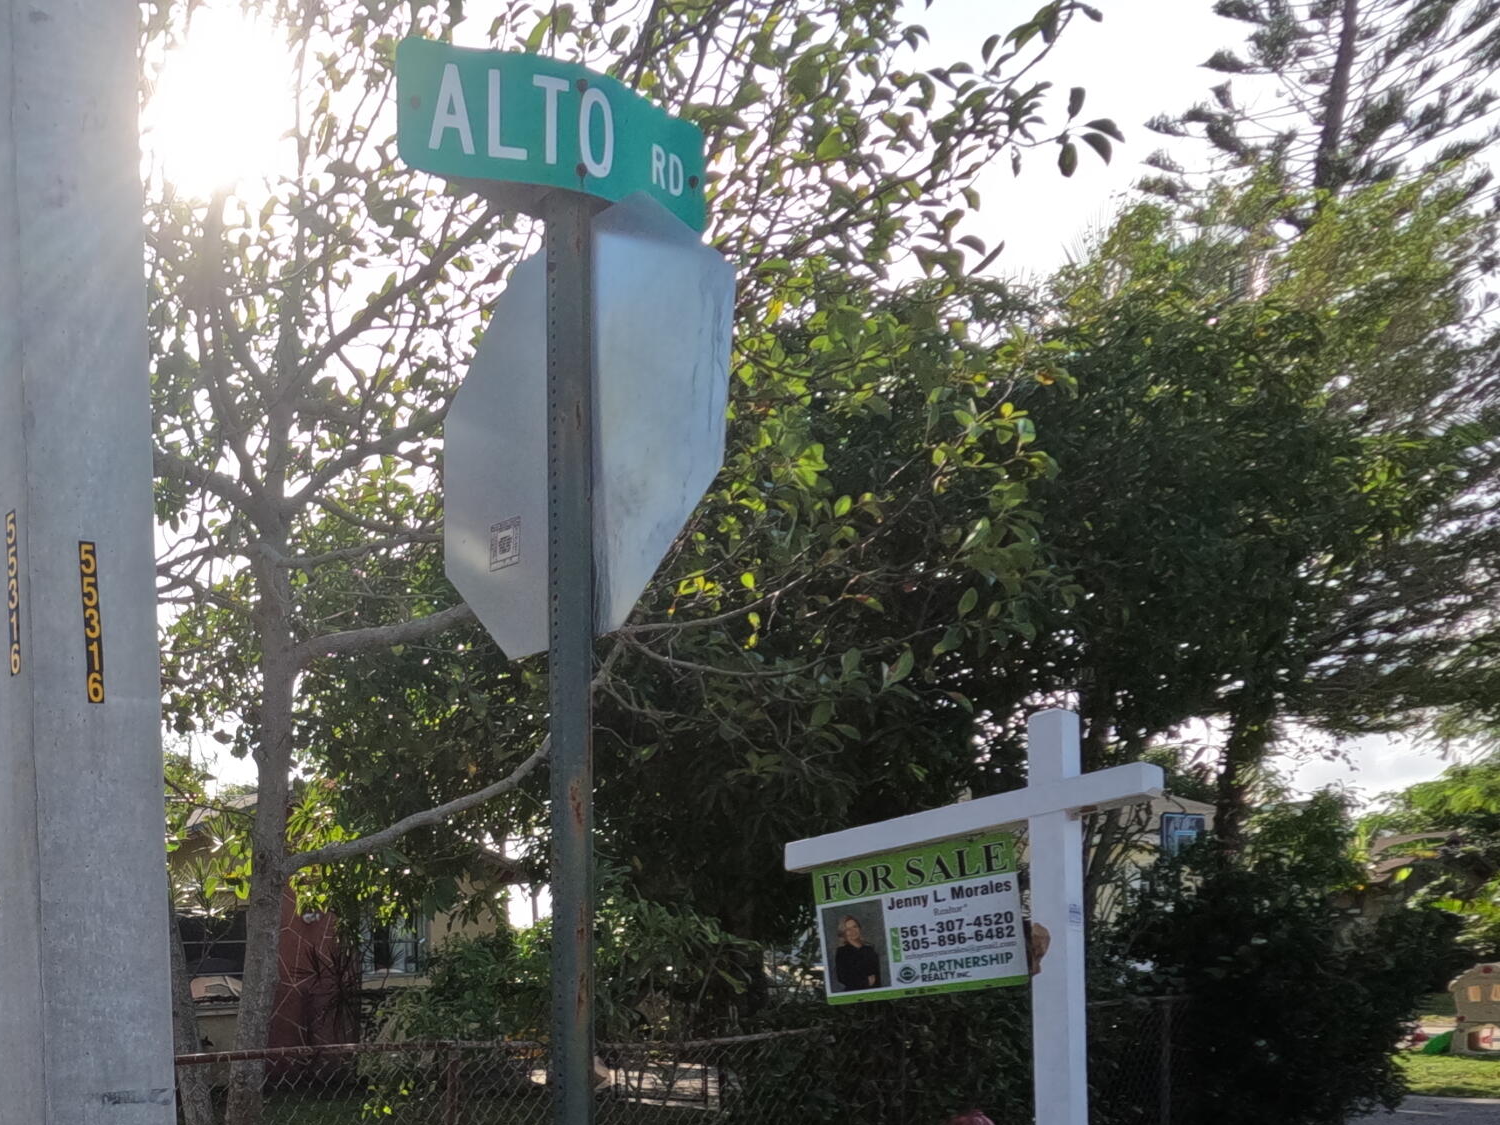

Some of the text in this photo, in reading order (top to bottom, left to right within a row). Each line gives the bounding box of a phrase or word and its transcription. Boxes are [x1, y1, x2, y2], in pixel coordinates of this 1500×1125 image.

[428, 63, 684, 197] ALTO RD
[6, 513, 21, 675] 55316
[79, 543, 105, 704] 55316
[820, 841, 1009, 901] FOR SALE
[887, 880, 1012, 911] Jenny L. Morales
[900, 911, 1014, 938] 561-307-4520
[902, 925, 1016, 951] 305-896-6482
[920, 951, 1013, 973] PARTNERSHIP
[921, 970, 956, 982] REALTY
